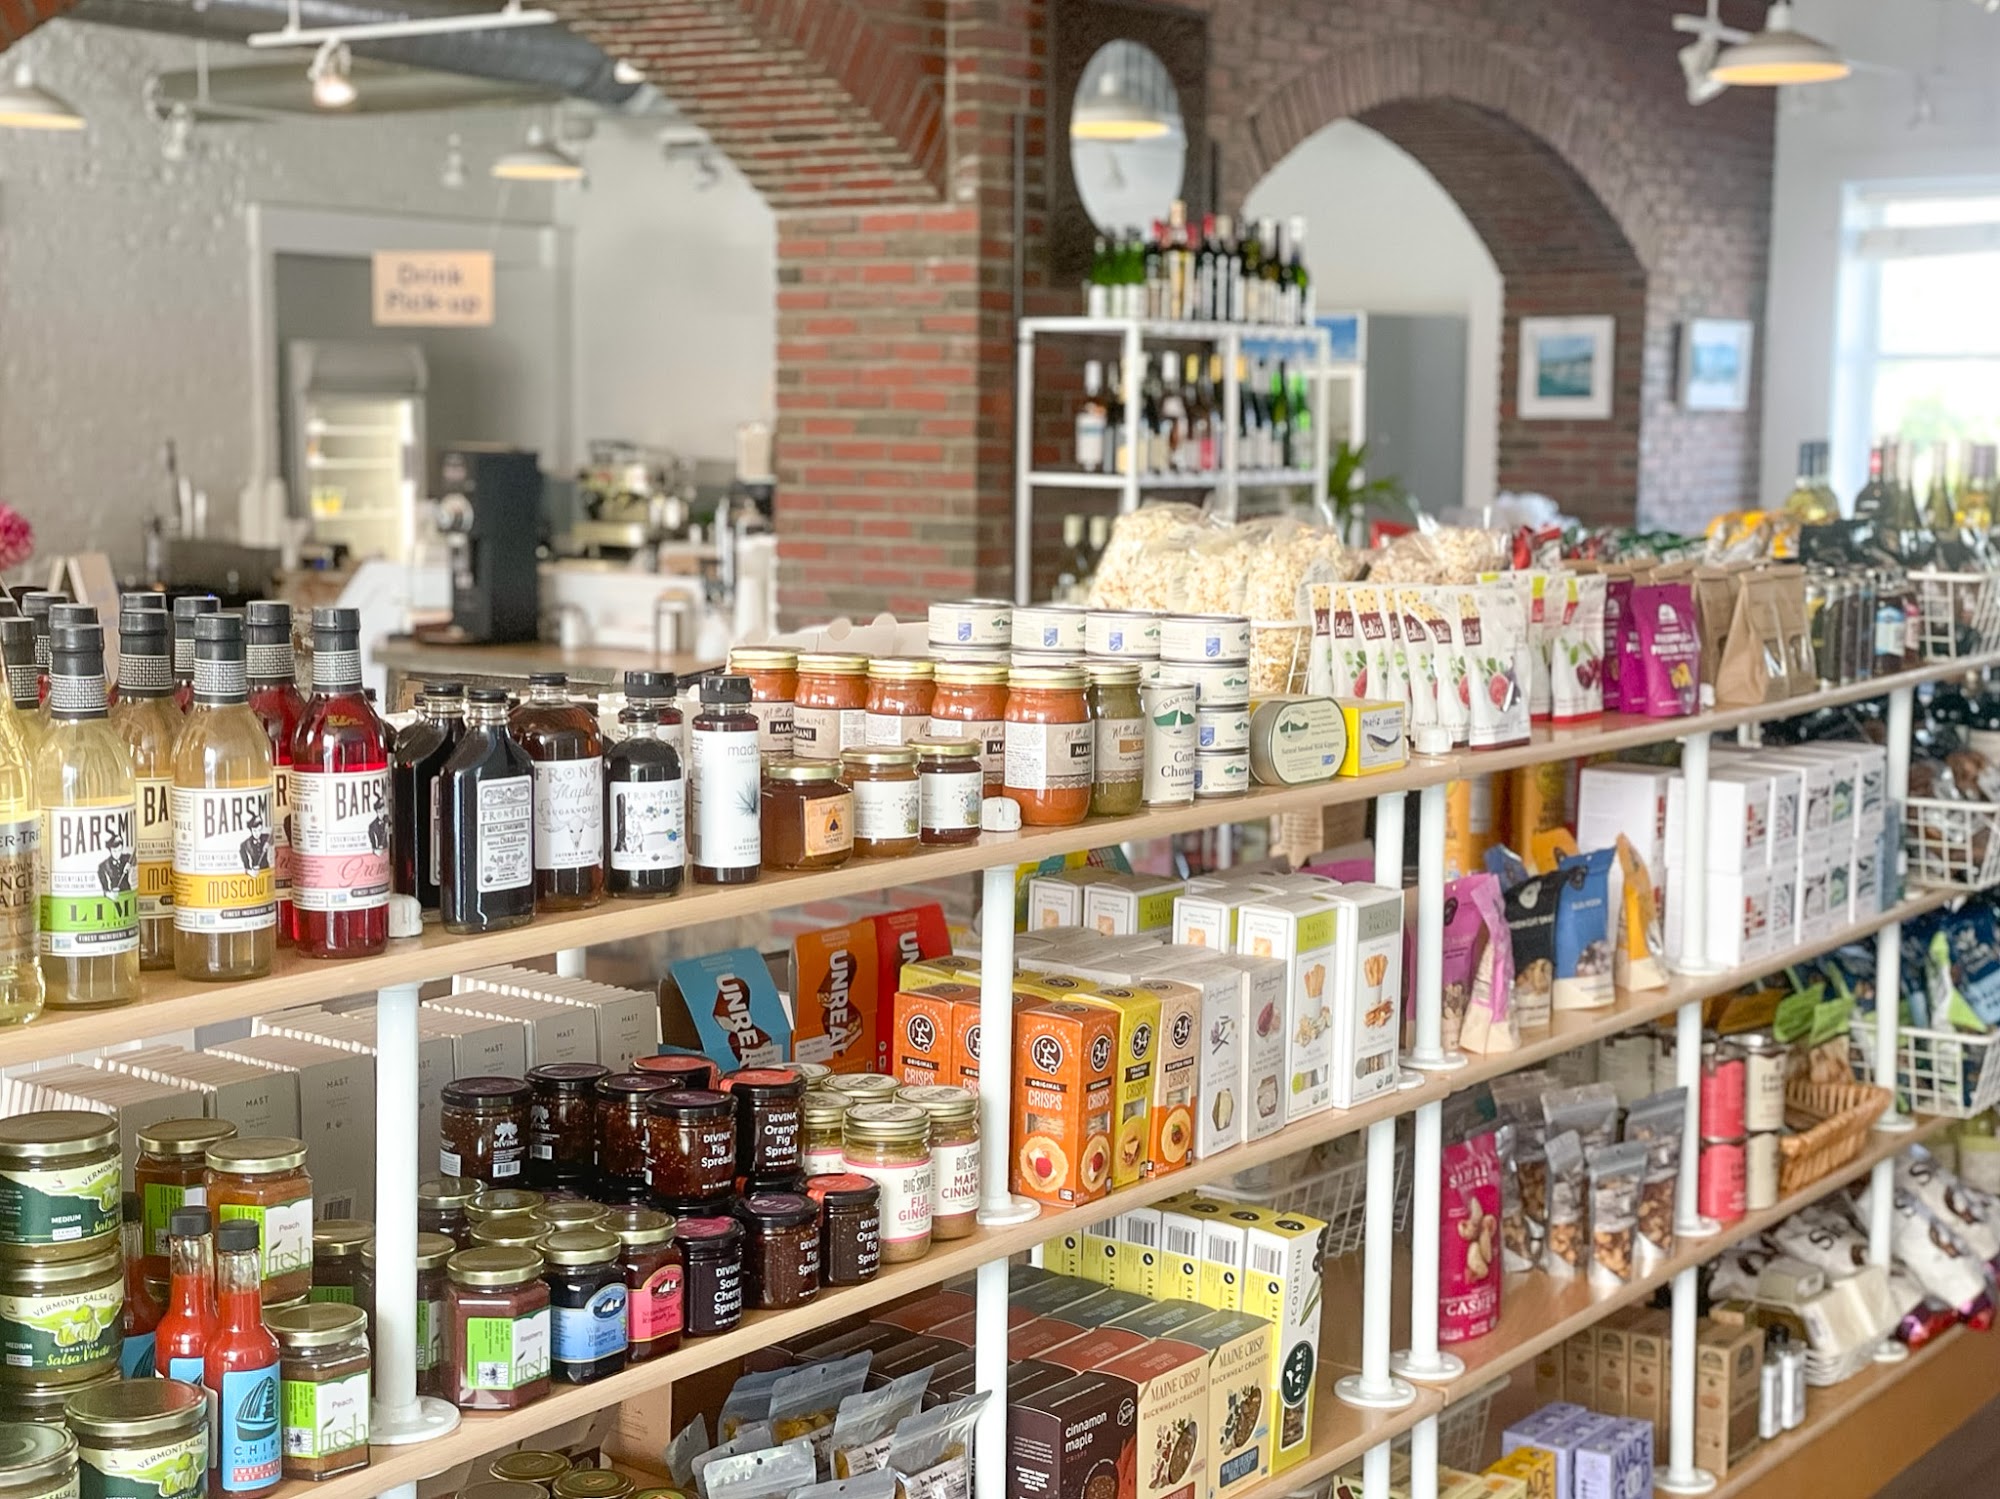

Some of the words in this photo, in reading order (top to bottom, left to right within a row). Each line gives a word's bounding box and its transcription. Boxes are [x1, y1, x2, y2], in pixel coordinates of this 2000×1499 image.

[621, 1013, 638, 1023] MAST
[557, 1029, 575, 1039] MAST
[485, 1044, 503, 1053] MAST
[907, 1058, 934, 1069] ORIGINAL
[326, 1077, 349, 1088] MAST
[904, 1067, 935, 1086] CRISPS
[1030, 1079, 1061, 1091] ORIGINAL
[246, 1096, 269, 1108] MAST
[1027, 1090, 1063, 1111] CRISPS
[1087, 1089, 1110, 1110] CRISPS
[764, 1123, 799, 1137] Orange
[776, 1136, 791, 1147] Fig
[711, 1144, 726, 1156] Fig
[765, 1145, 798, 1158] Spread
[701, 1153, 733, 1169] Spread
[903, 1179, 916, 1194] BIG
[51, 1213, 81, 1224] MEDIUM
[278, 1221, 300, 1233] Peach
[866, 1241, 878, 1253] Fig
[267, 1236, 311, 1275] fresh
[807, 1251, 818, 1262] Fig
[719, 1276, 740, 1290] Sour
[33, 1297, 81, 1317] VERMONT
[83, 1293, 107, 1304] SALSA
[5, 1341, 33, 1350] MEDIUM
[1218, 1346, 1244, 1368] MAINE
[1244, 1335, 1265, 1358] CRISP
[46, 1353, 81, 1367] Salsa
[1211, 1366, 1244, 1386] BUCKWHEAT
[1244, 1353, 1270, 1372] CRACKERS
[1293, 1348, 1305, 1397] LARK
[1150, 1378, 1178, 1403] MAINE
[1178, 1367, 1201, 1391] CRISP
[332, 1397, 354, 1410] Peach
[1143, 1398, 1178, 1420] BUCKWHEAT
[1179, 1385, 1207, 1403] CRACKERS
[1065, 1411, 1108, 1439] cinnamon
[320, 1412, 367, 1453] fresh
[1065, 1432, 1094, 1453] maple
[137, 1445, 183, 1470] VERMONT
